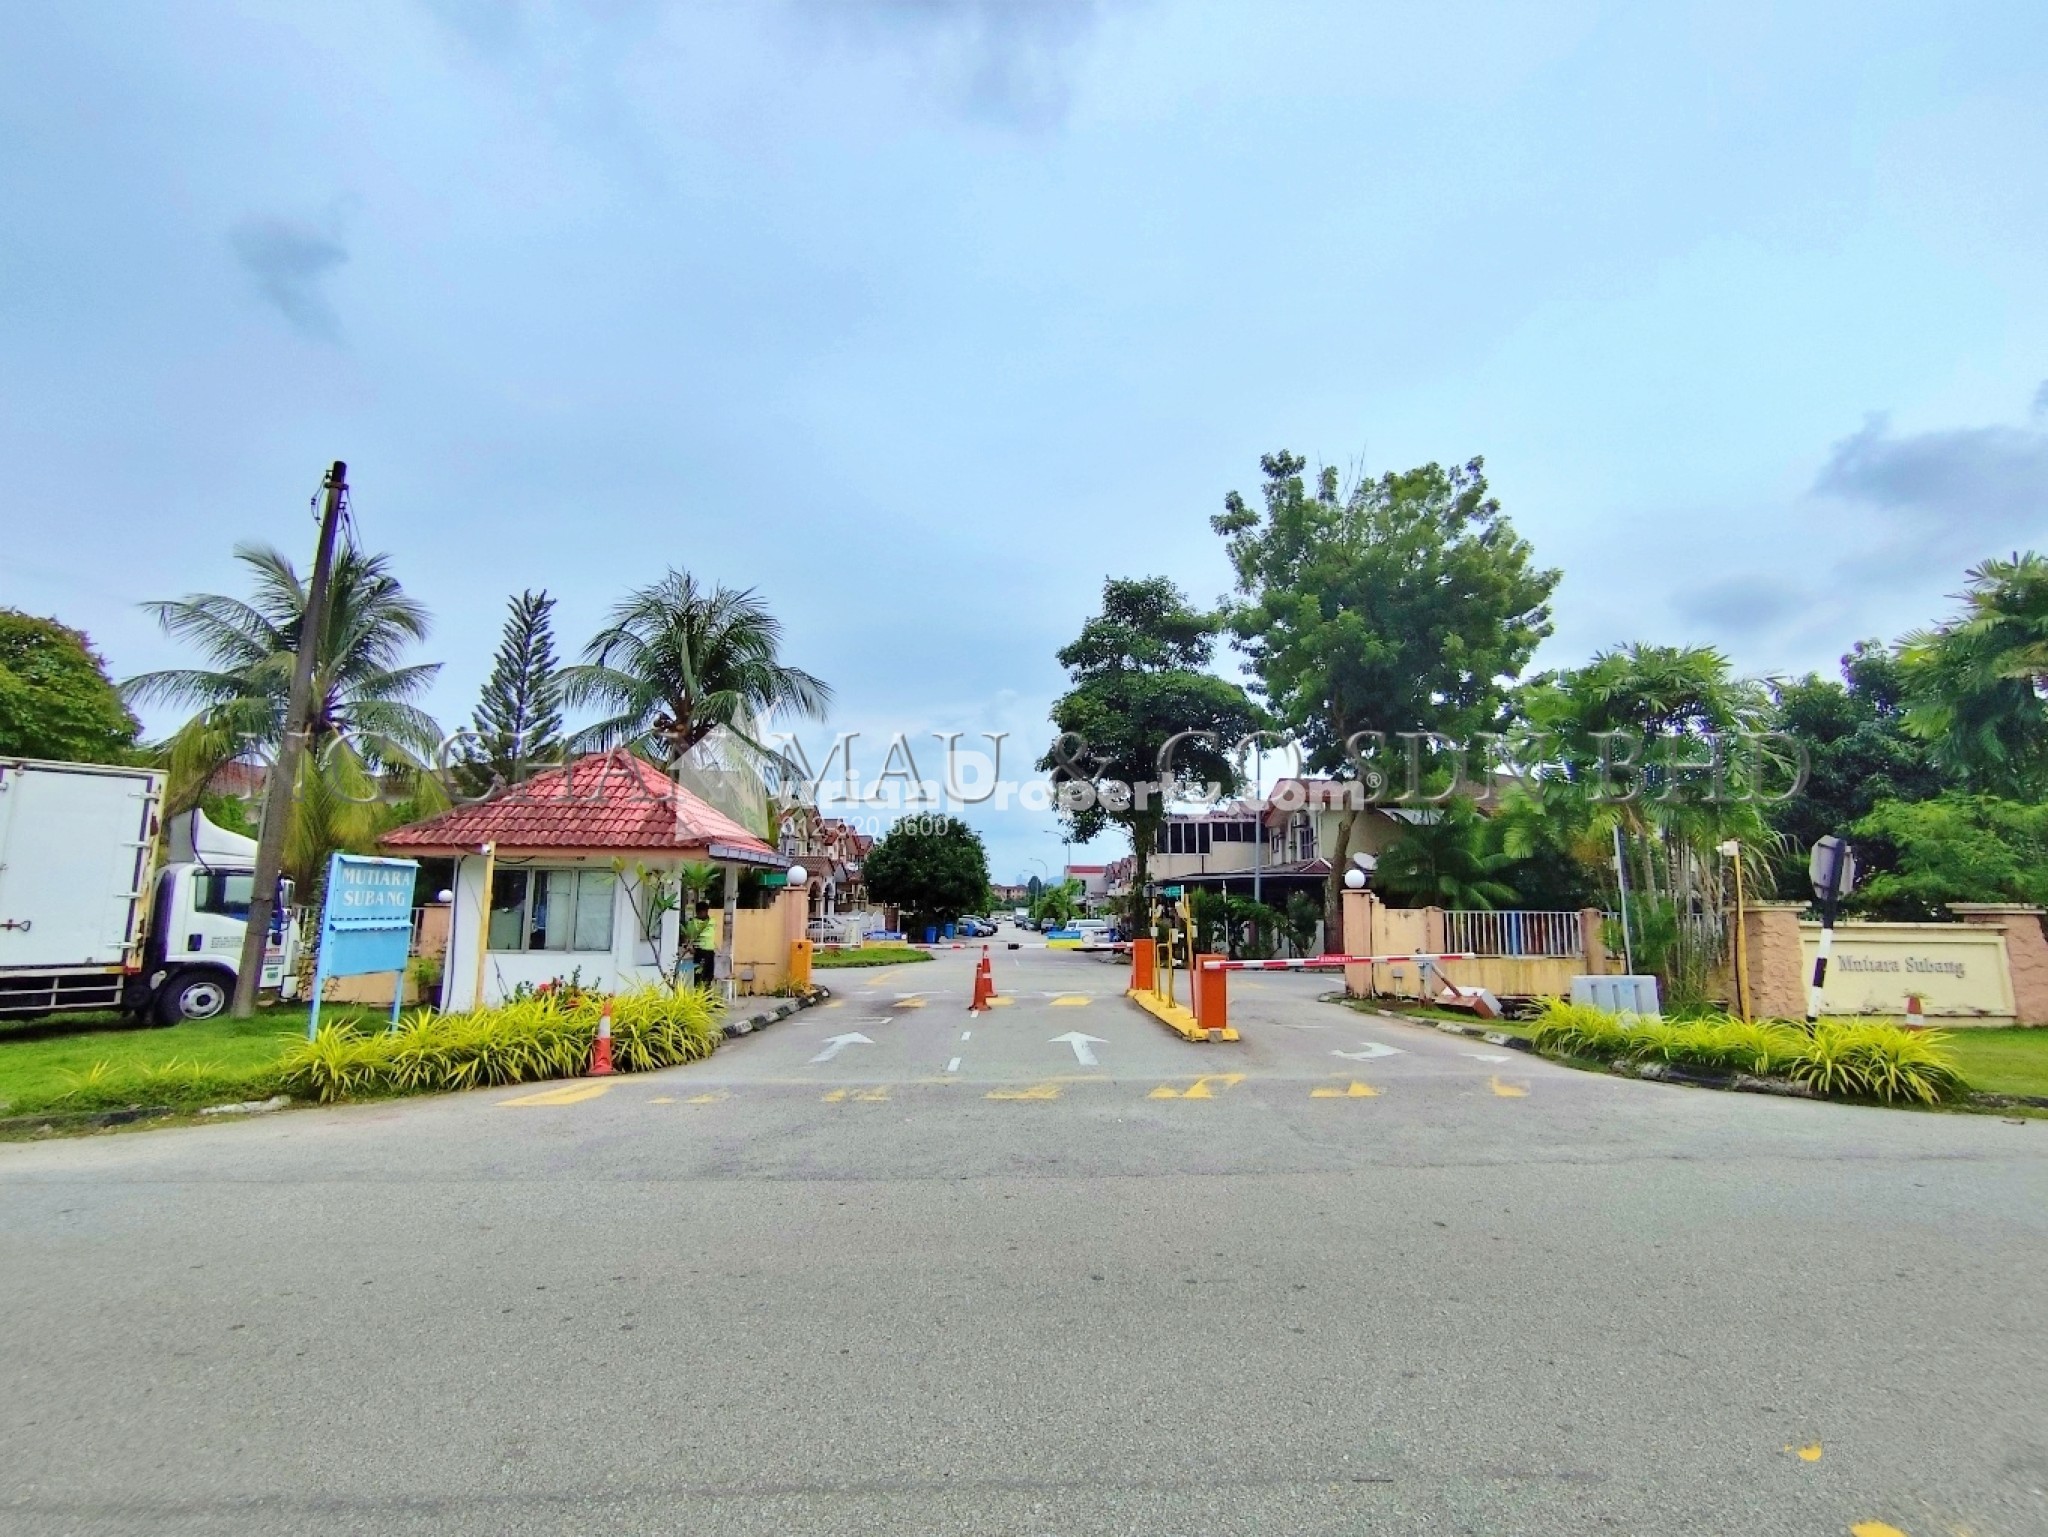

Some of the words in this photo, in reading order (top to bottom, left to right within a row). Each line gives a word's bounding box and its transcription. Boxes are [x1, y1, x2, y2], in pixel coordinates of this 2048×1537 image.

[342, 867, 410, 886] MUTIARA
[343, 890, 405, 906] SUBANG
[1905, 956, 1965, 978] Subang
